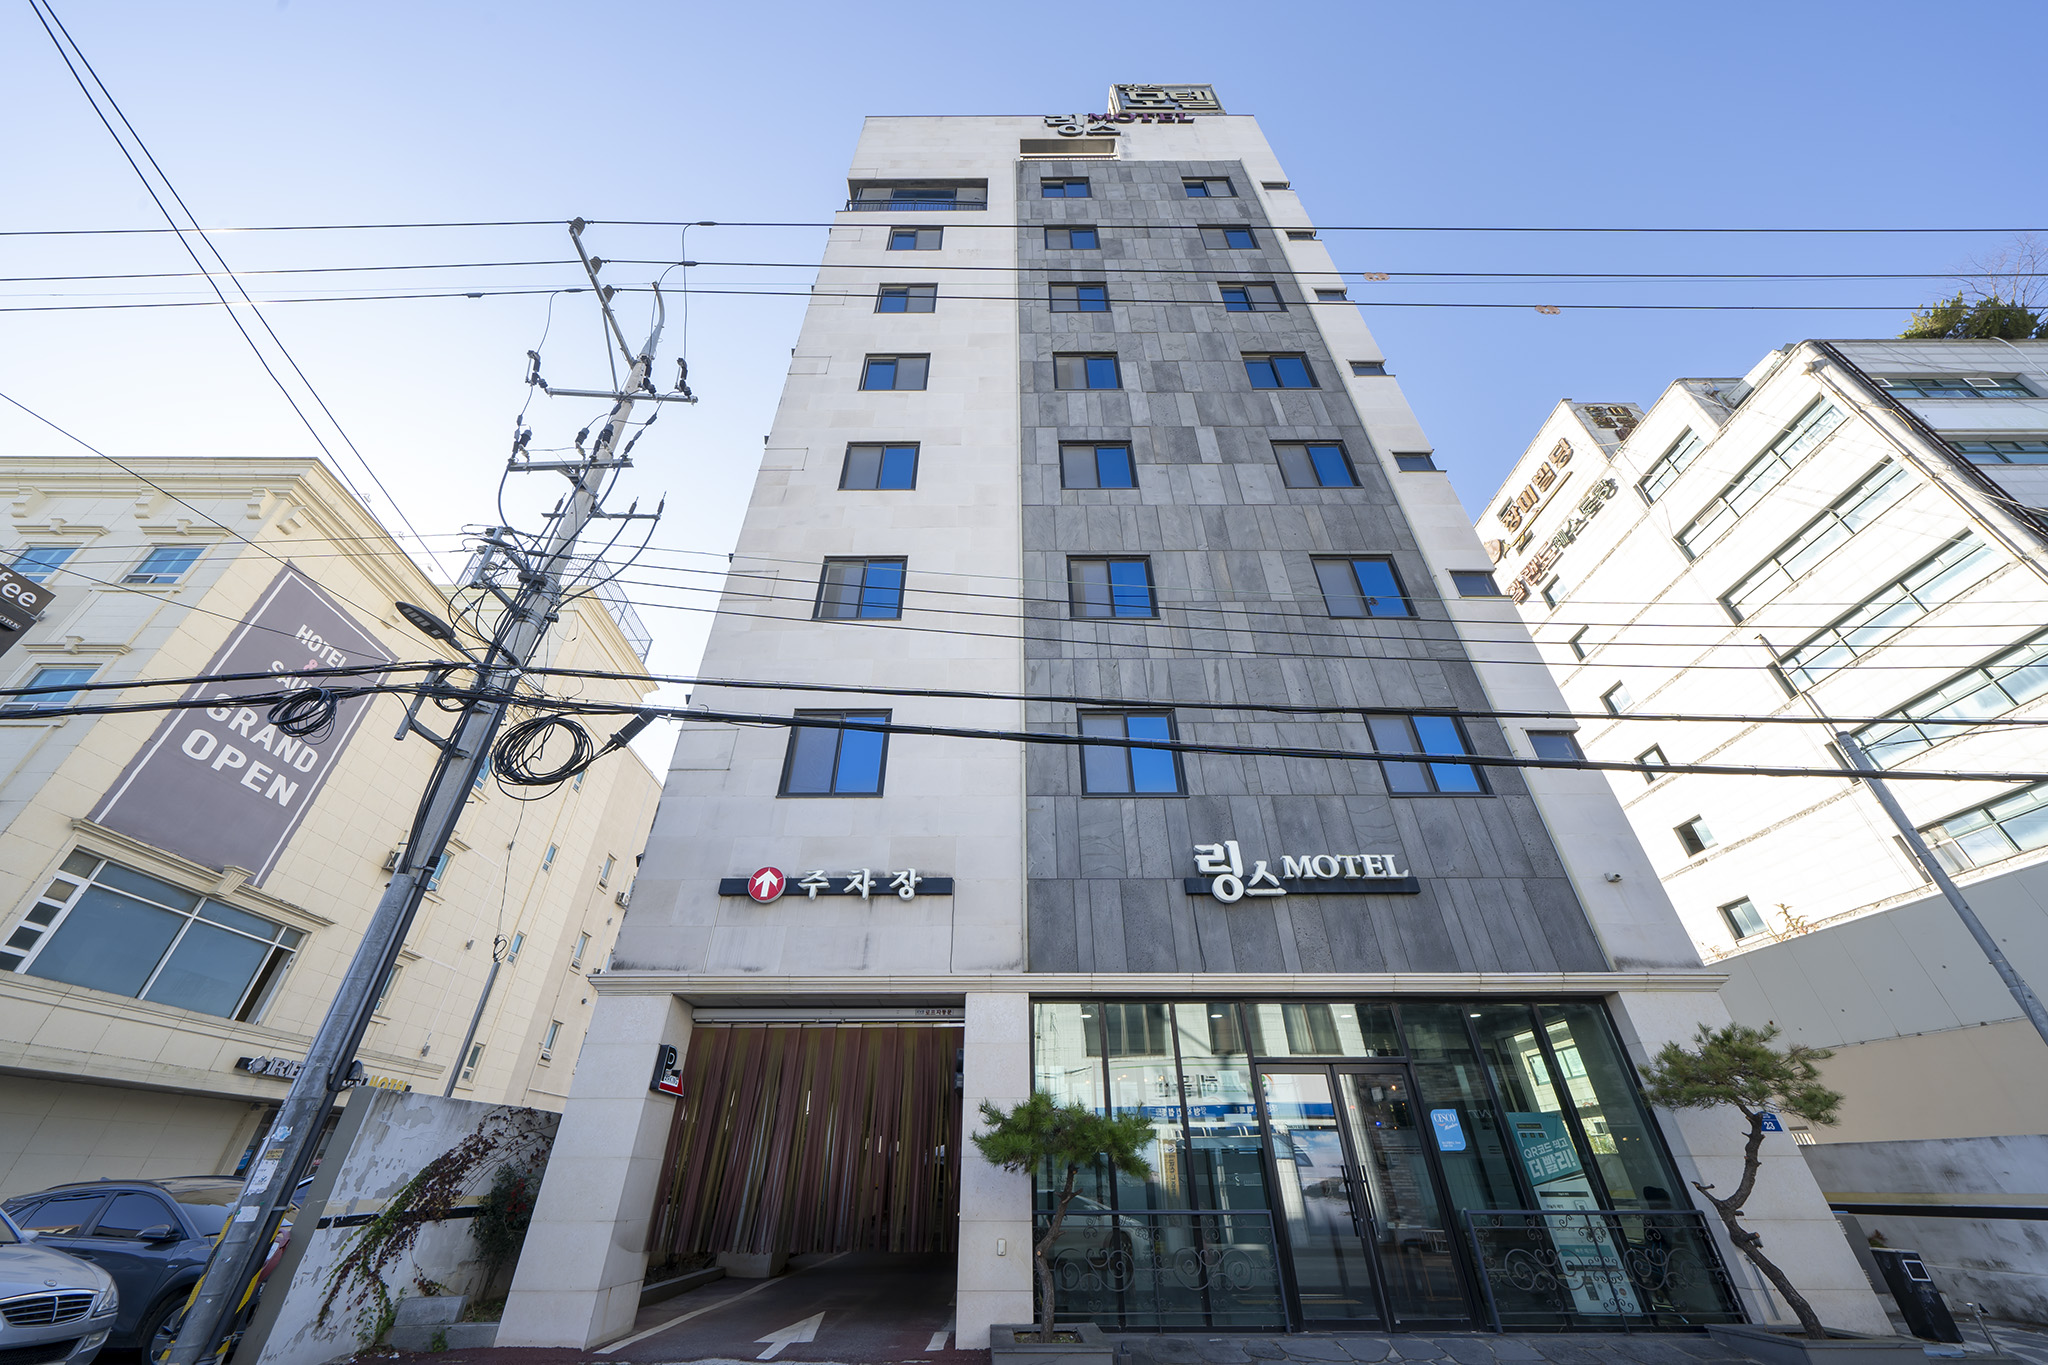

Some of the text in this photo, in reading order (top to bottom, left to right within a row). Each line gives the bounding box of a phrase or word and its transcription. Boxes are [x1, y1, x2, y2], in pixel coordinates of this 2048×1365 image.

[1125, 90, 1219, 110] 모텔
[1044, 112, 1195, 137] 링스 MOTEL
[1502, 437, 1574, 532] 장미빌딩
[206, 693, 318, 773] GRAND
[181, 729, 299, 807] OPEN
[798, 868, 922, 900] 주차장
[1193, 840, 1409, 904] 링스 MOTEL
[1764, 1121, 1776, 1130] 23
[1523, 1142, 1553, 1159] QR코드
[1527, 1158, 1545, 1178] 더
